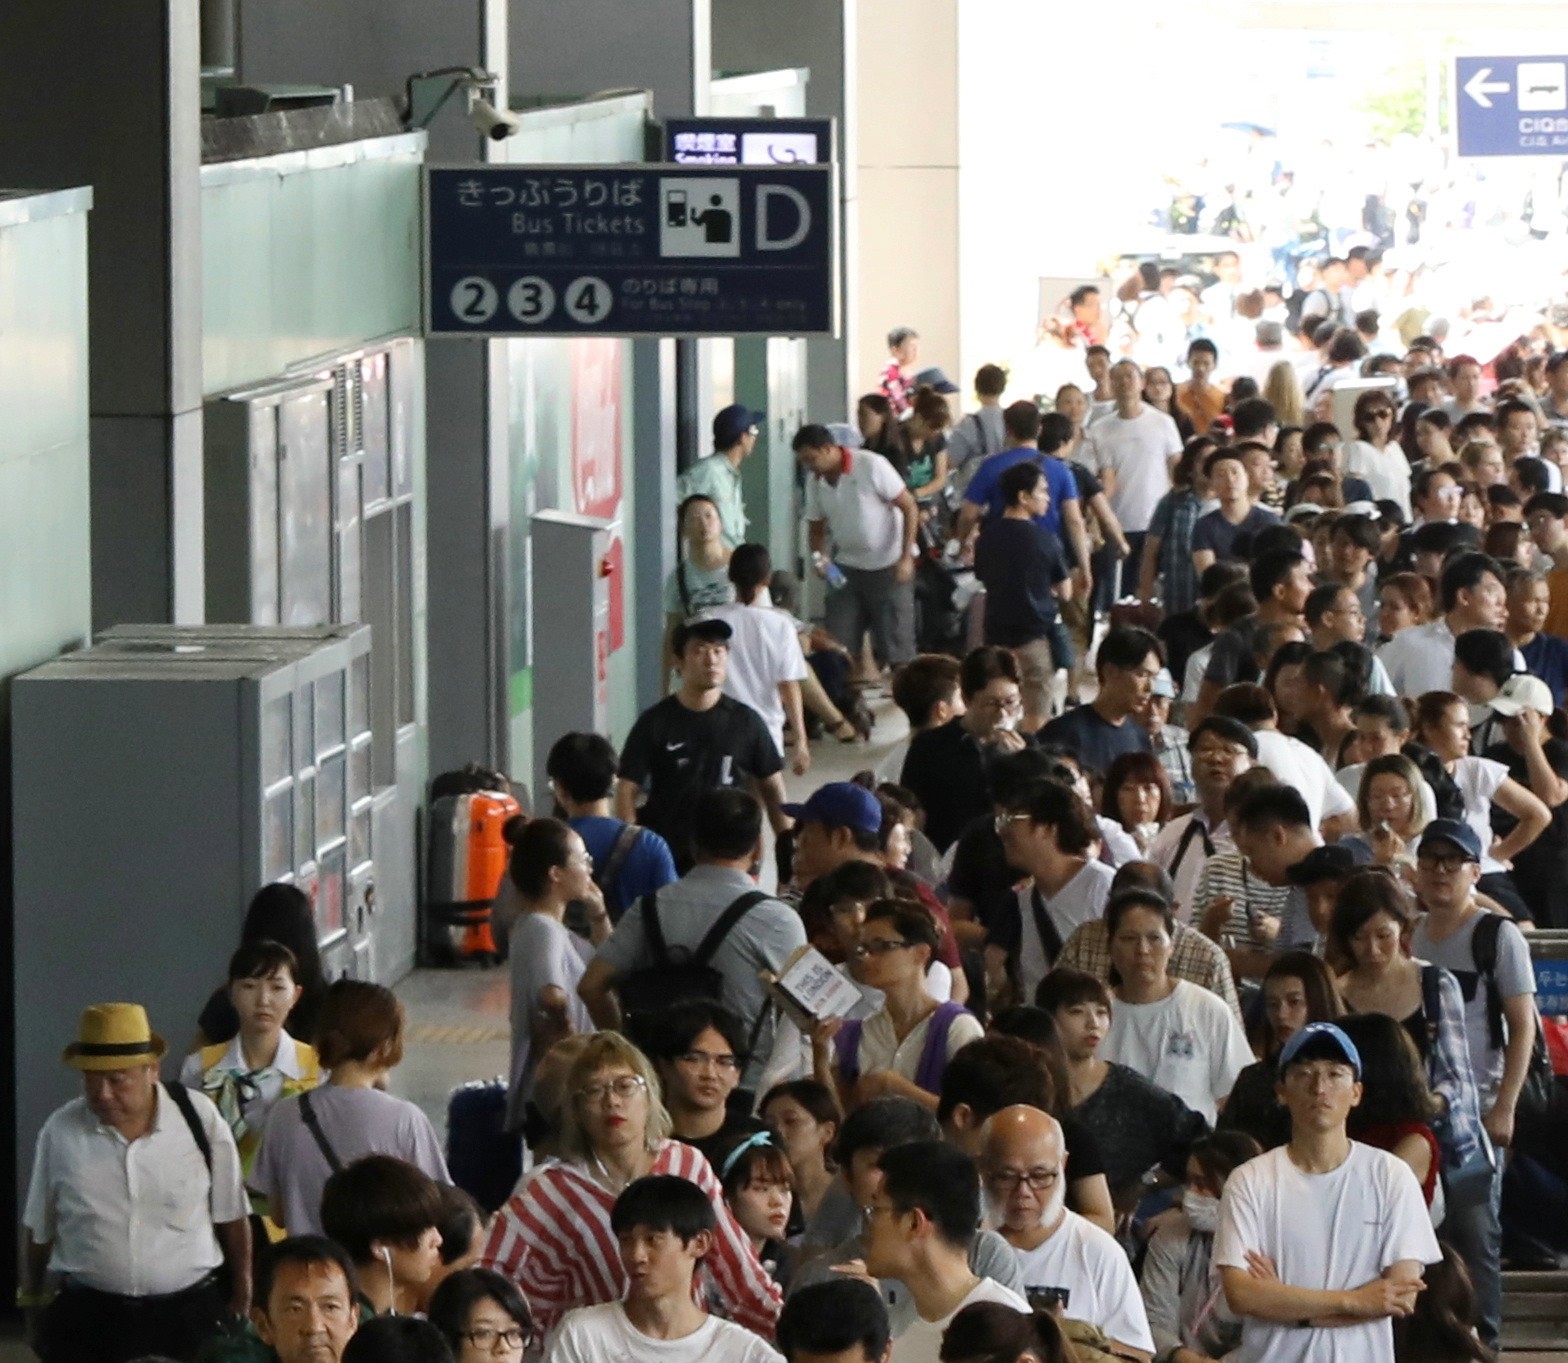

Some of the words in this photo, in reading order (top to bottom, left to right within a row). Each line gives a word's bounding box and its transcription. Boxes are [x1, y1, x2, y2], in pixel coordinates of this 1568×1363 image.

[456, 178, 644, 207] きっぷうりば
[511, 213, 553, 235] Bus
[563, 213, 645, 235] Tickets
[755, 183, 812, 251] D
[463, 282, 487, 318] 2
[520, 282, 544, 318] 3
[573, 282, 600, 318] 4
[622, 277, 719, 295] のりば専用
